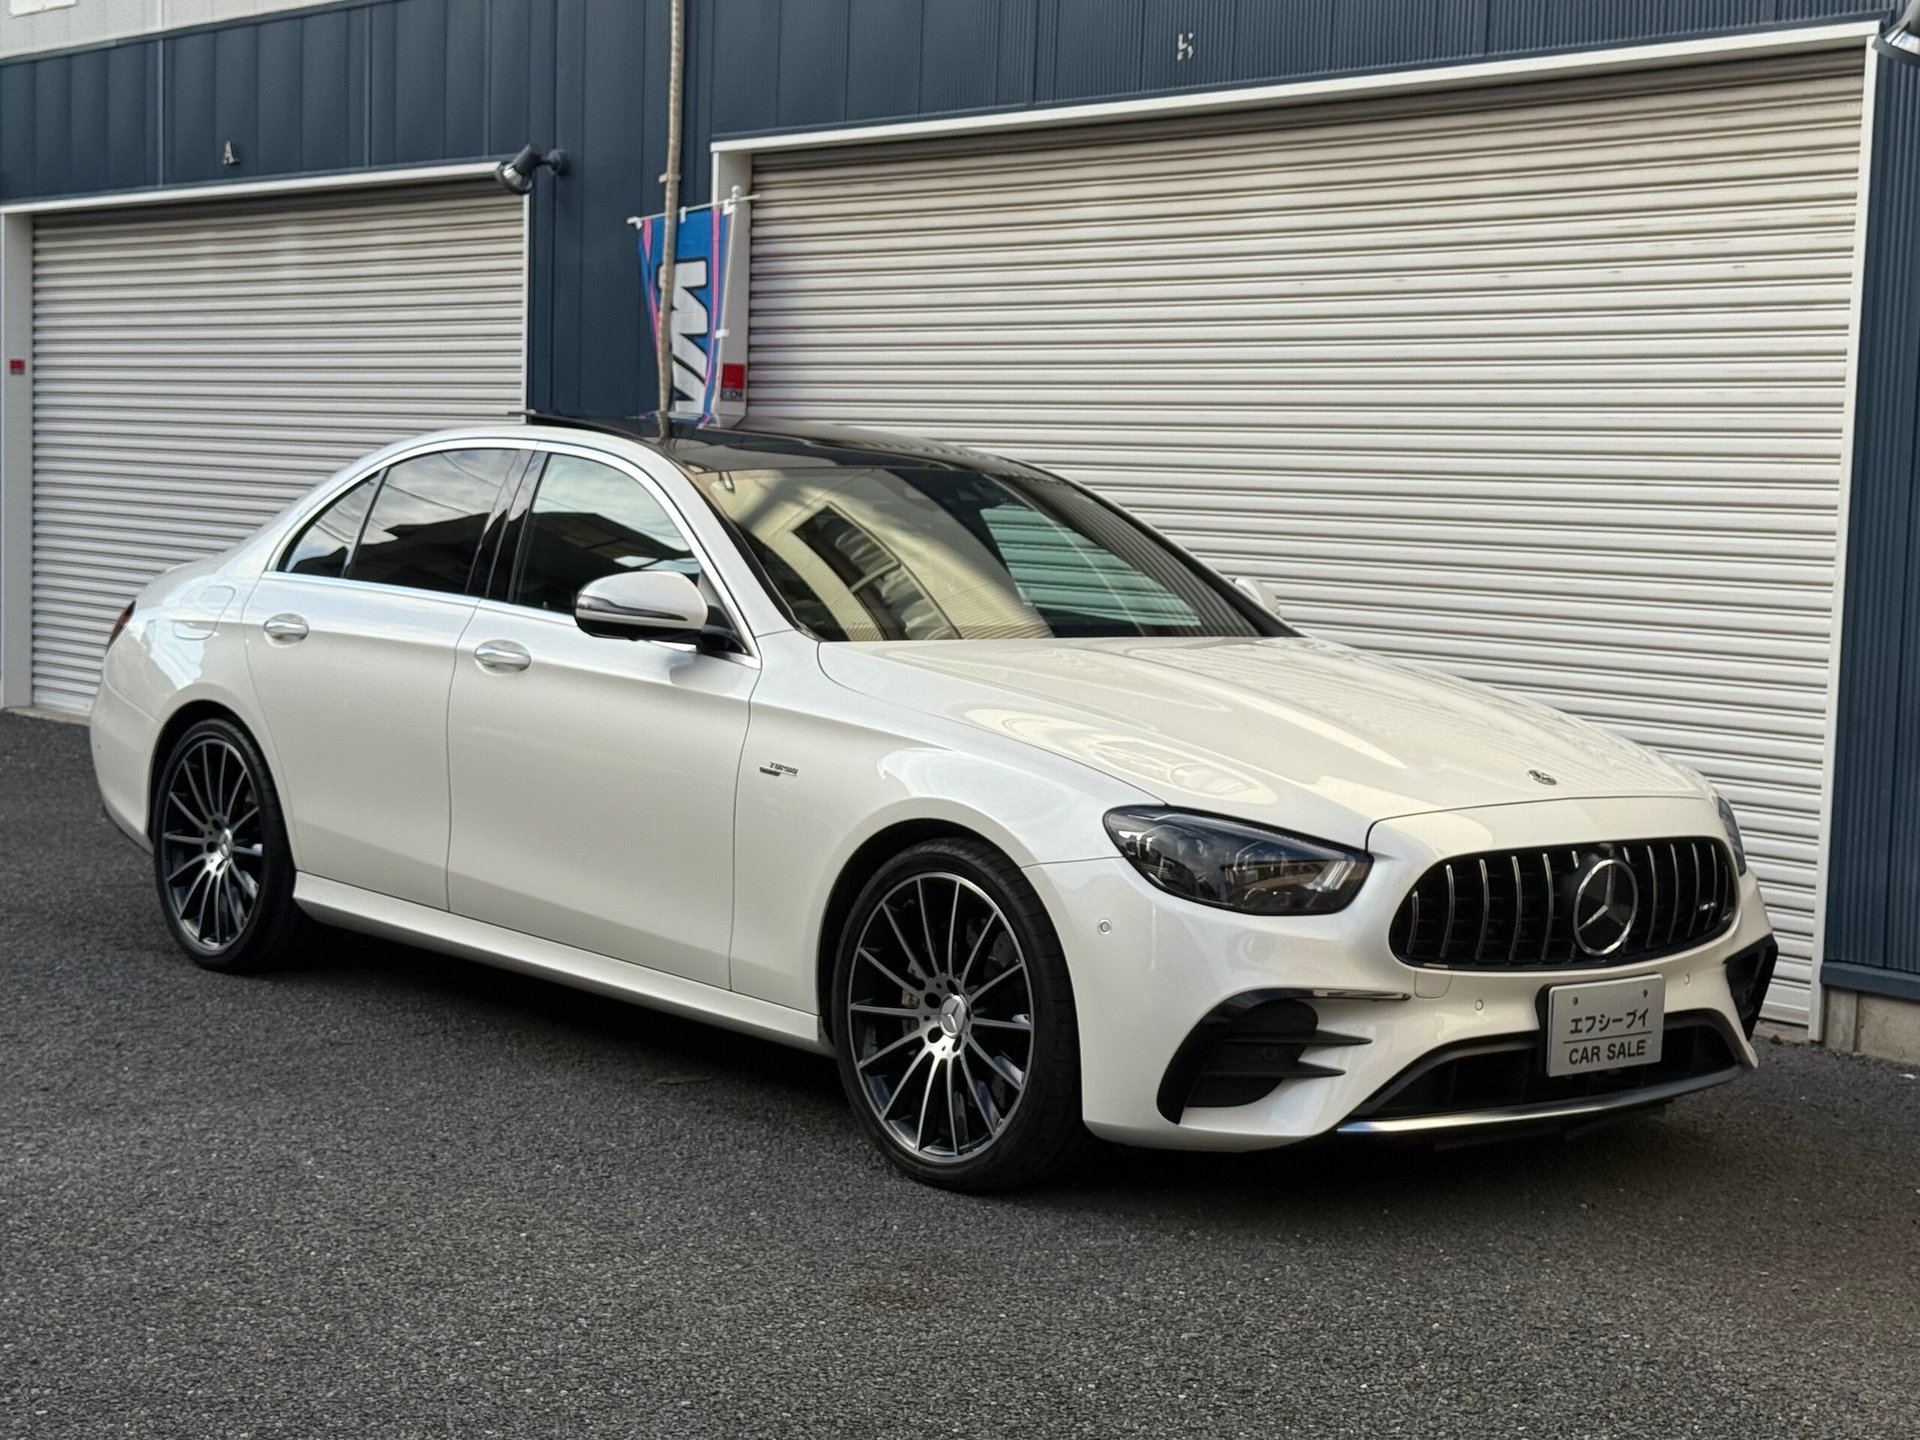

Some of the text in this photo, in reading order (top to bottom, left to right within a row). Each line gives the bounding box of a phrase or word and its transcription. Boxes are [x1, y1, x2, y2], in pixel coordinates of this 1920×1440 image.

[1569, 1008, 1649, 1034] エフシーブイ
[1569, 1040, 1646, 1065] CAR SALE
